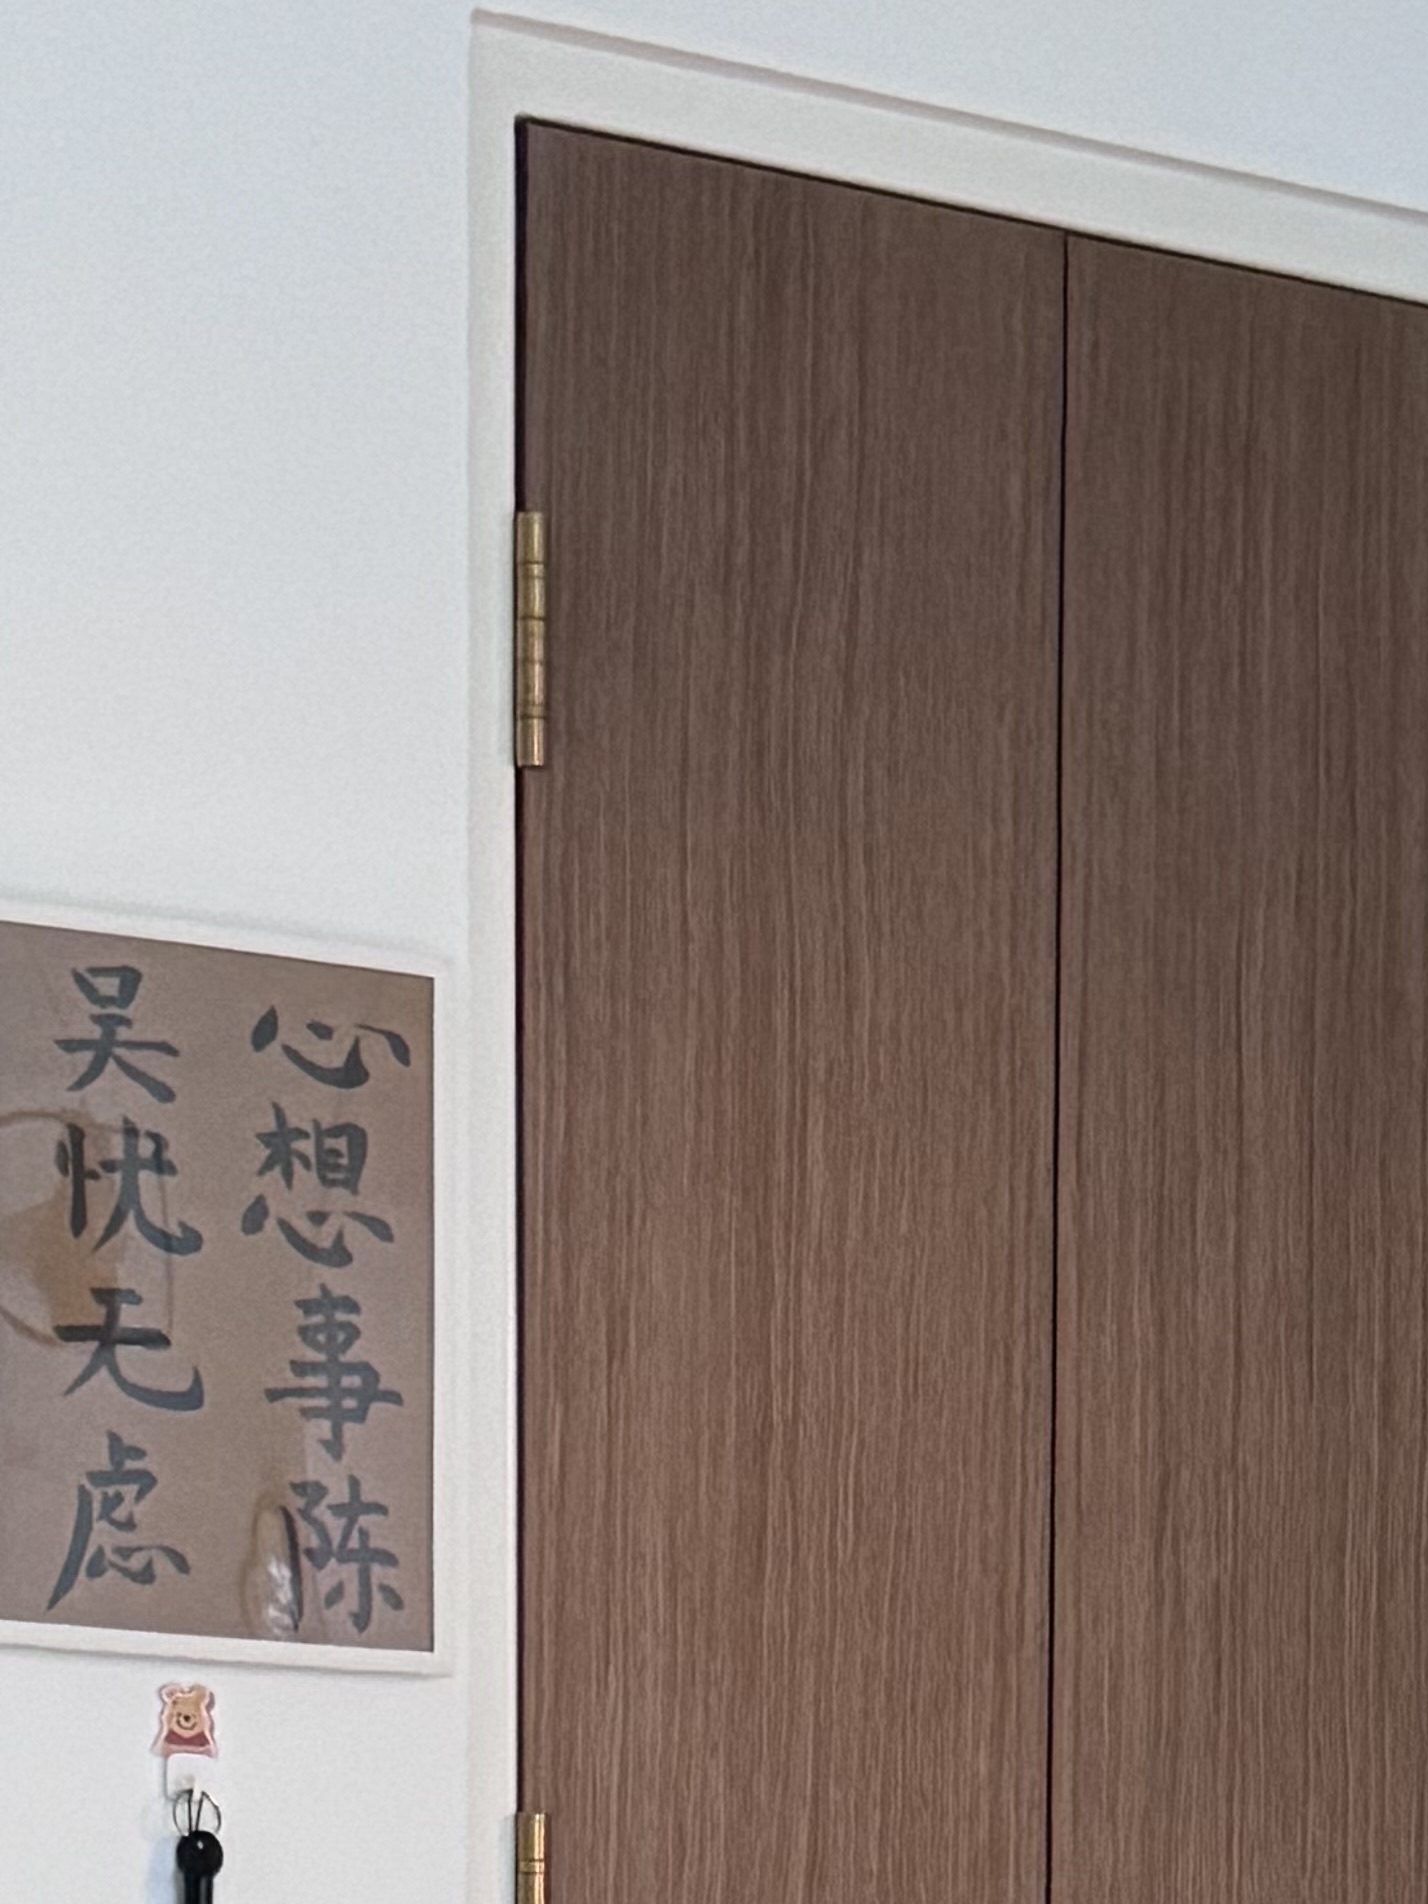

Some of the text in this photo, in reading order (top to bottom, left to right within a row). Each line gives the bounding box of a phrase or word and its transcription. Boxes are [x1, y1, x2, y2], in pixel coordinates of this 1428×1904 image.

[46, 964, 204, 1612] 吴忧无虑
[241, 1004, 411, 1634] 心想事陈
